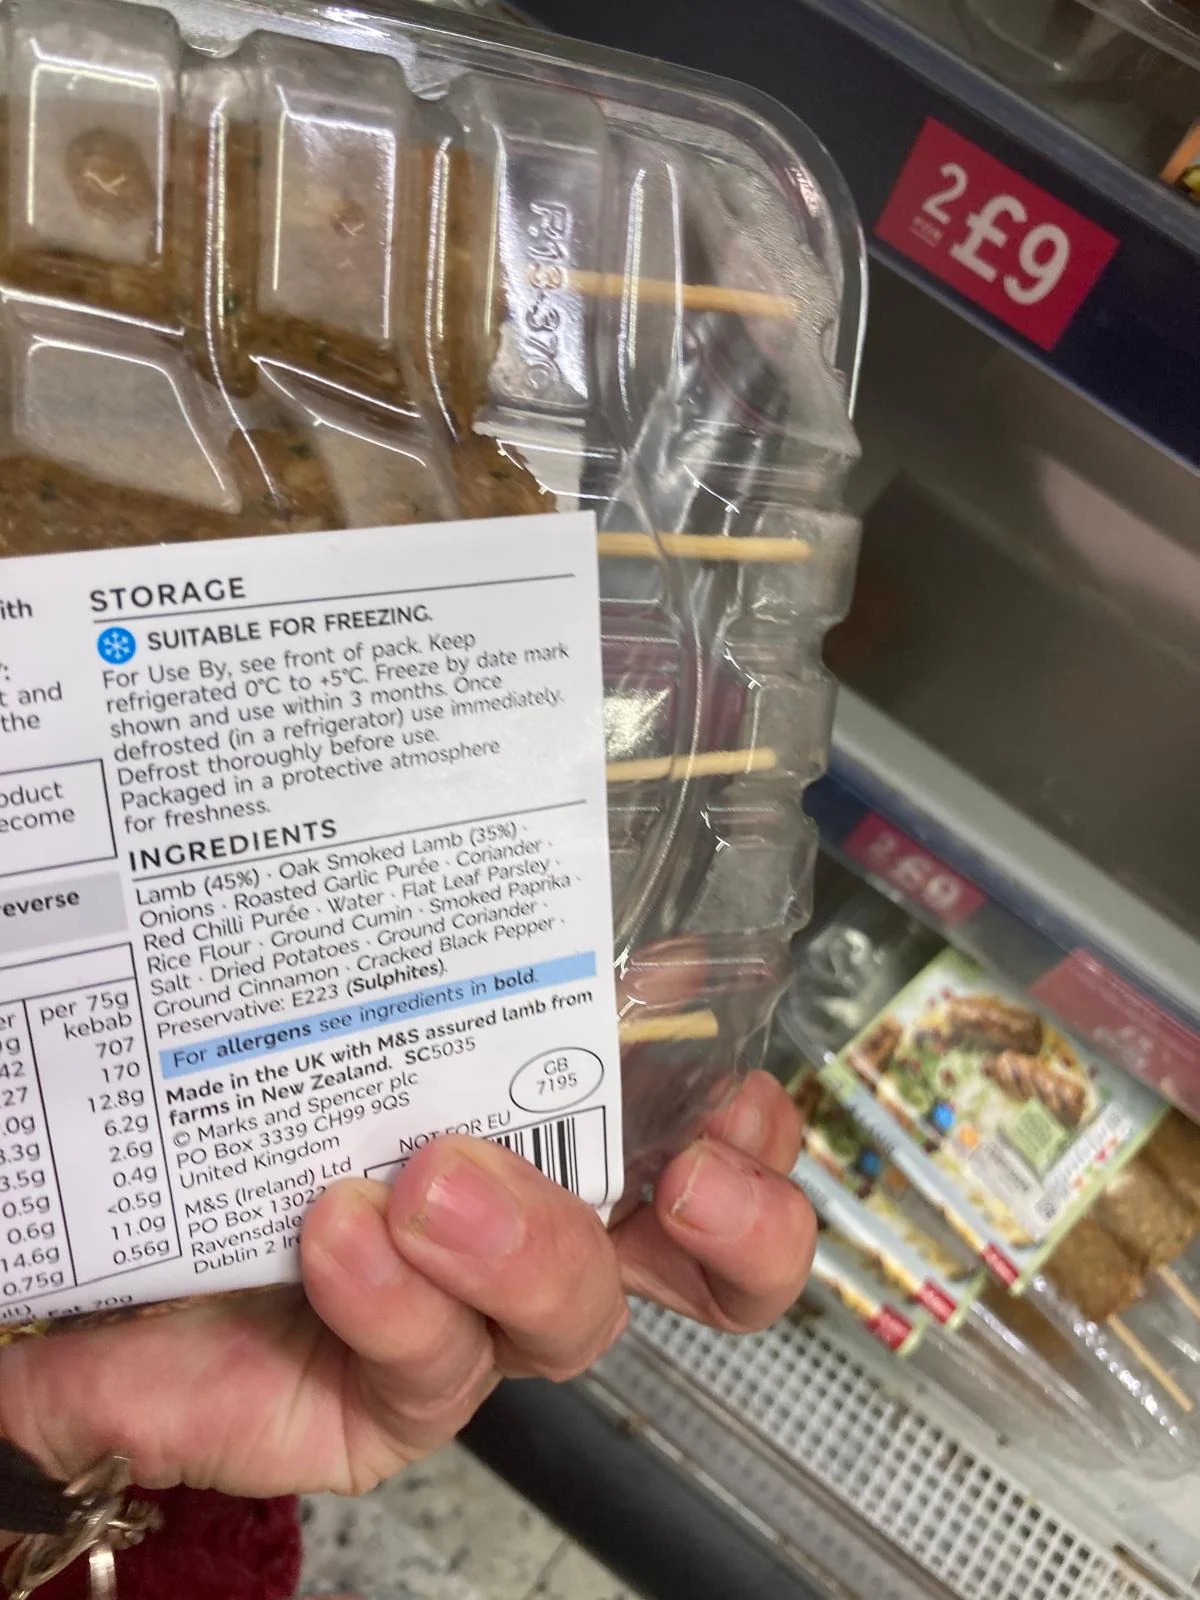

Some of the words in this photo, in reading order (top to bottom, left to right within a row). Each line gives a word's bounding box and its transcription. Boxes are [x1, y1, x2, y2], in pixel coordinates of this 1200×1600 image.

[921, 162, 968, 225] 2
[949, 194, 1070, 306] £9
[90, 577, 246, 612] STORAGE
[147, 623, 261, 651] SUITABLE
[270, 616, 316, 638] FOR
[324, 605, 432, 632] FREEZING.
[103, 670, 139, 690] For
[149, 665, 190, 684] Use
[199, 660, 233, 682] By,
[240, 656, 276, 674] see
[284, 648, 336, 669] front
[343, 642, 364, 662] of
[372, 637, 422, 662] pack.
[428, 633, 477, 652] Keep
[106, 683, 237, 713] refrigerated
[289, 676, 312, 692] to
[375, 660, 439, 682] Freeze
[446, 656, 471, 676] by
[476, 650, 518, 670] date
[523, 642, 569, 664] mark
[18, 681, 62, 706] and
[110, 718, 180, 739] shown
[189, 707, 230, 729] and
[238, 705, 275, 722] use
[282, 693, 343, 716] within
[350, 691, 363, 708] 3
[370, 681, 448, 706] months.
[454, 674, 502, 694] Once
[0, 712, 41, 733] the
[113, 732, 220, 762] defrosted
[229, 729, 254, 751] (in
[263, 728, 276, 743] a
[283, 707, 404, 740] refrigerator)
[411, 704, 444, 722] use
[450, 687, 564, 718] immediately.
[117, 760, 200, 787] Defrost
[208, 743, 322, 774] thoroughly
[330, 734, 395, 757] before
[402, 728, 440, 747] use.
[121, 778, 226, 811] Packaged
[235, 776, 253, 794] in
[262, 775, 275, 790] a
[281, 757, 383, 791] protective
[390, 739, 501, 770] atmosphere
[124, 814, 156, 834] for
[165, 799, 271, 829] freshness.
[128, 819, 338, 872] INGREDIENTS
[136, 881, 196, 905] Lamb
[203, 868, 260, 897] (45%)
[279, 857, 321, 879] Oak
[326, 841, 405, 871] Smoked
[412, 831, 463, 855] Lamb
[469, 821, 517, 847] (35%)
[139, 902, 215, 929] Onions
[234, 879, 317, 911] Roasted
[324, 868, 379, 893] Garlic
[386, 856, 440, 882] Purée
[456, 838, 543, 868] Coriander
[143, 928, 185, 951] Red
[193, 916, 243, 942] Chilli
[251, 904, 310, 930] Purée
[327, 891, 384, 915] Water
[402, 879, 436, 900] Flat
[443, 869, 481, 891] Leaf
[487, 858, 550, 882] Parsley
[147, 952, 191, 975] Rice
[200, 940, 250, 964] Flour
[270, 919, 344, 947] Ground
[352, 905, 412, 931] Cumin
[430, 887, 501, 914] Smoked
[508, 873, 571, 901] Paprika
[150, 974, 192, 996] Salt
[211, 956, 265, 984] Dried
[272, 938, 360, 969] Potatoes
[377, 917, 445, 946] Ground
[451, 900, 538, 929] Coriander
[154, 986, 231, 1018] Ground
[238, 964, 339, 998] Cinnamon
[356, 941, 433, 972] Cracked
[439, 929, 488, 954] Black
[494, 916, 556, 942] Pepper
[40, 1001, 78, 1026] per
[85, 991, 129, 1012] 75g
[156, 997, 286, 1039] Preservative:
[292, 983, 339, 1008] E223
[347, 957, 447, 998] (Sulphites).
[64, 1012, 133, 1039] kebab
[173, 1048, 208, 1069] For
[216, 1021, 312, 1058] allergens
[319, 1012, 352, 1033] see
[359, 986, 465, 1023] ingredients
[471, 980, 487, 998] in
[494, 968, 538, 992] bold.
[95, 1036, 134, 1059] 707
[166, 1078, 224, 1105] Made
[230, 1073, 249, 1089] in
[256, 1064, 289, 1084] the
[295, 1053, 325, 1074] UK
[331, 1041, 372, 1064] with
[377, 1029, 420, 1052] M&S
[426, 1010, 497, 1039] assured
[502, 1001, 546, 1022] lamb
[551, 990, 593, 1011] from
[543, 1057, 569, 1076] GB
[101, 1061, 141, 1083] 170
[169, 1100, 230, 1127] farms
[236, 1093, 255, 1110] in
[262, 1081, 305, 1104] New
[311, 1056, 392, 1090] Zealand.
[404, 1036, 476, 1066] SC5035
[536, 1073, 578, 1096] 7195
[87, 1089, 145, 1113] 12.8g
[198, 1115, 258, 1143] Marks
[264, 1101, 301, 1123] and
[307, 1081, 383, 1115] Spencer
[389, 1070, 419, 1091] plc
[487, 1110, 511, 1129] EU
[104, 1114, 149, 1137] 6.2g
[176, 1147, 207, 1170] PO
[214, 1139, 254, 1161] Box
[259, 1122, 308, 1148] 3339
[313, 1104, 366, 1132] CH99
[371, 1091, 411, 1115] 9QS
[109, 1141, 153, 1164] 2.6g
[179, 1158, 247, 1189] United
[253, 1135, 341, 1171] Kingdom
[113, 1165, 157, 1188] 0.4g
[184, 1193, 229, 1219] M&S
[235, 1168, 316, 1208] (Ireland)
[322, 1156, 352, 1179] Ltd
[2, 1195, 50, 1218] 0.5g
[107, 1190, 162, 1213] <0.5g
[7, 1221, 55, 1245] 0.6g
[111, 1214, 166, 1241] 11.0g
[187, 1217, 219, 1238] PO
[225, 1207, 264, 1229] Box
[191, 1214, 303, 1257] Ravensdale
[0, 1246, 60, 1273] 14.6g
[112, 1239, 170, 1265] 0.56g
[193, 1248, 258, 1275] Dublin
[265, 1240, 276, 1255] 2
[2, 1271, 64, 1297] 0.75g
